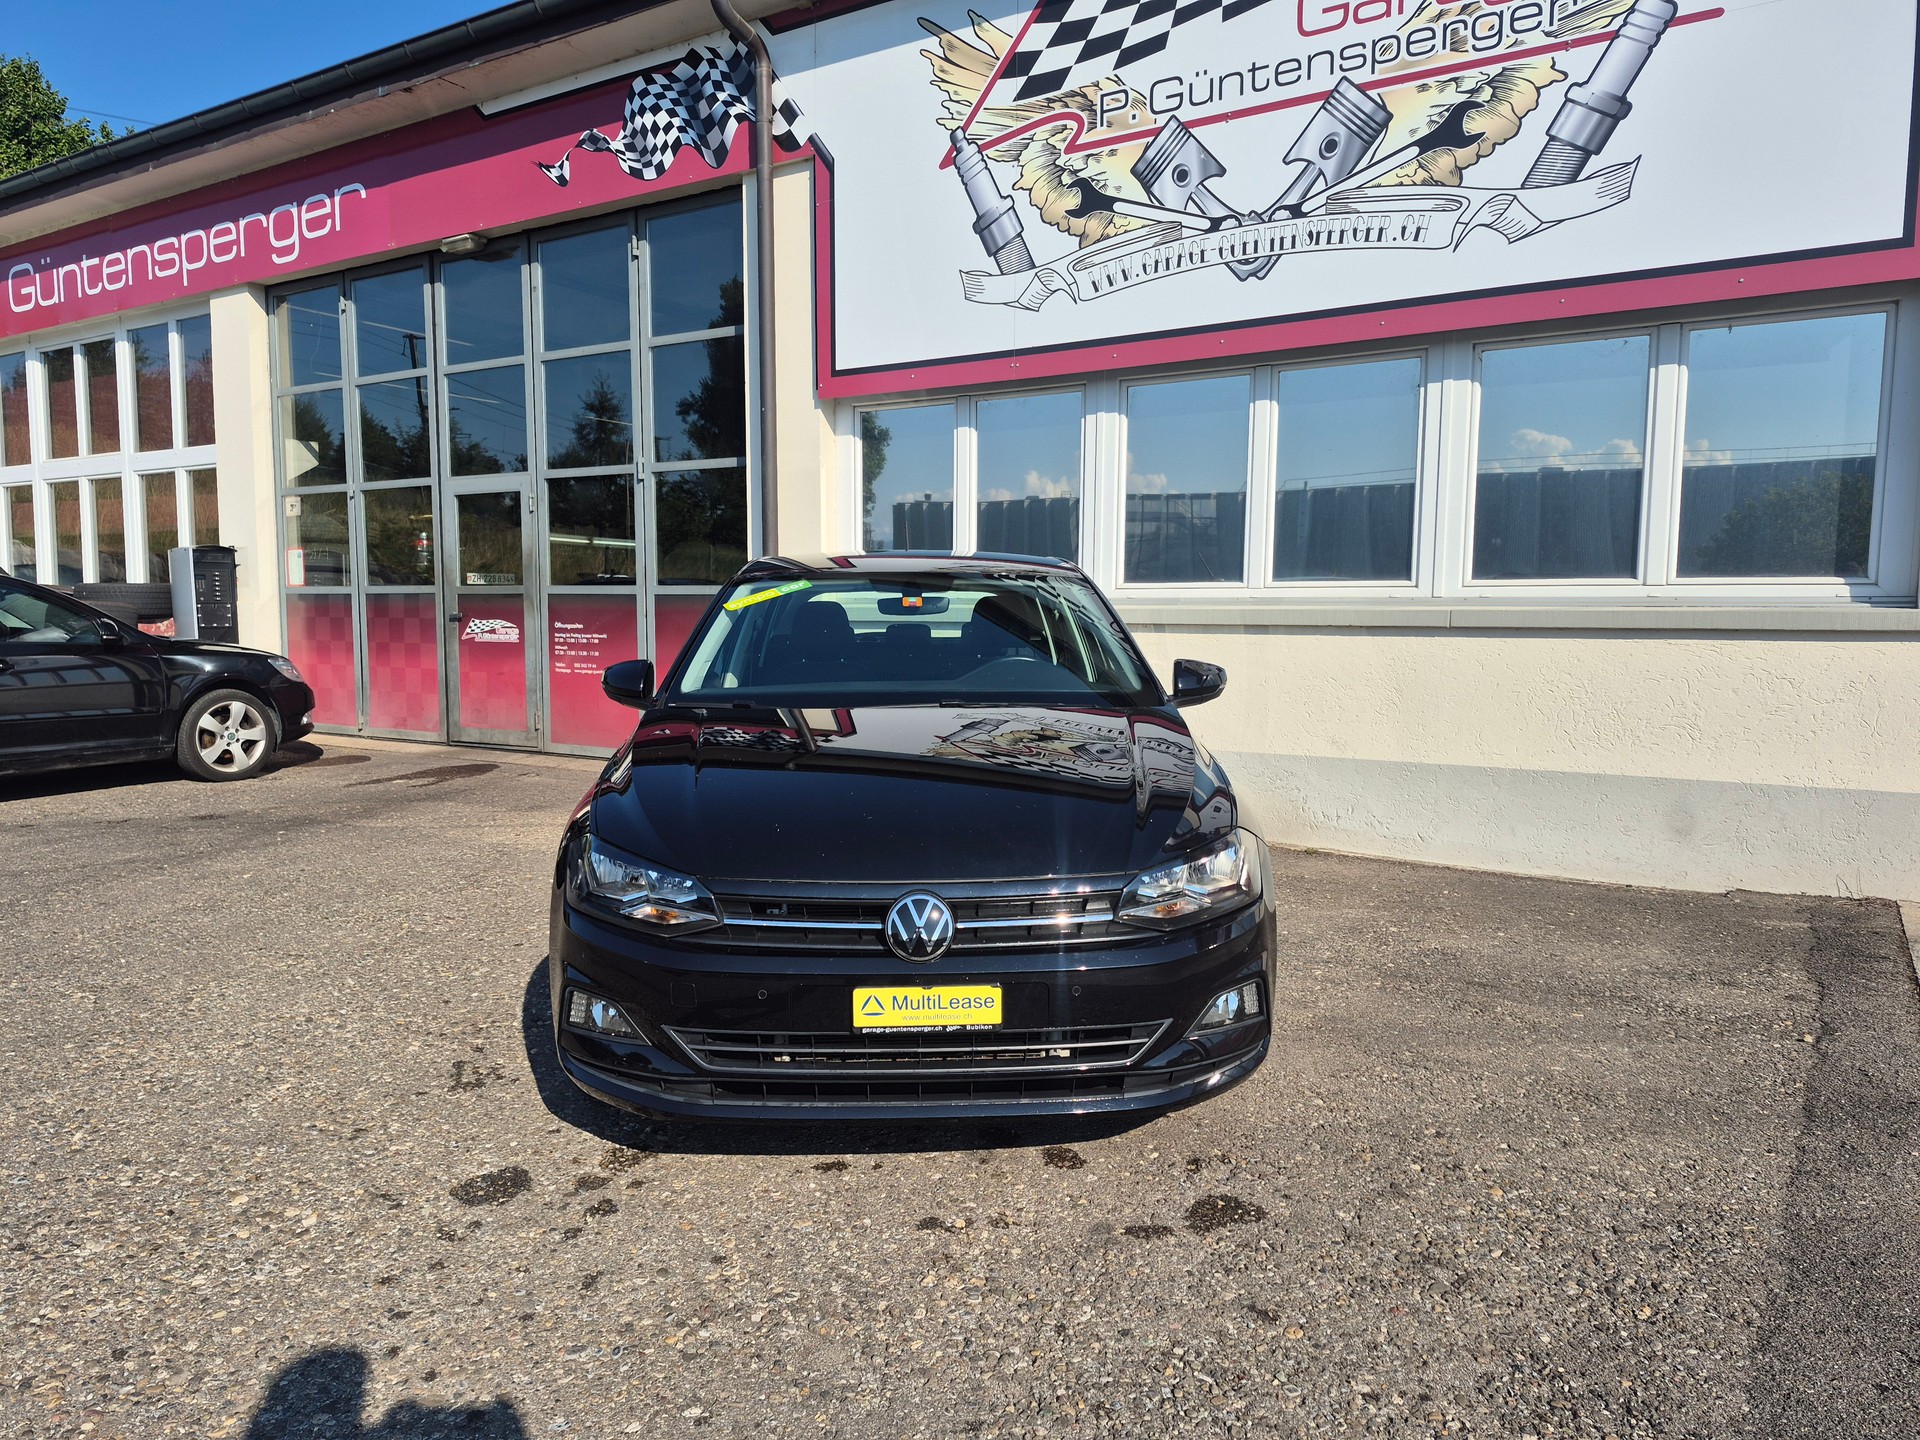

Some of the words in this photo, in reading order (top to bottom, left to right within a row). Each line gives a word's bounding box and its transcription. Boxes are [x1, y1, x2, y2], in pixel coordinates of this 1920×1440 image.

[8, 182, 367, 313] Güntensperger
[892, 994, 995, 1011] MultiLease
[902, 1012, 973, 1021] www.multilease.ch
